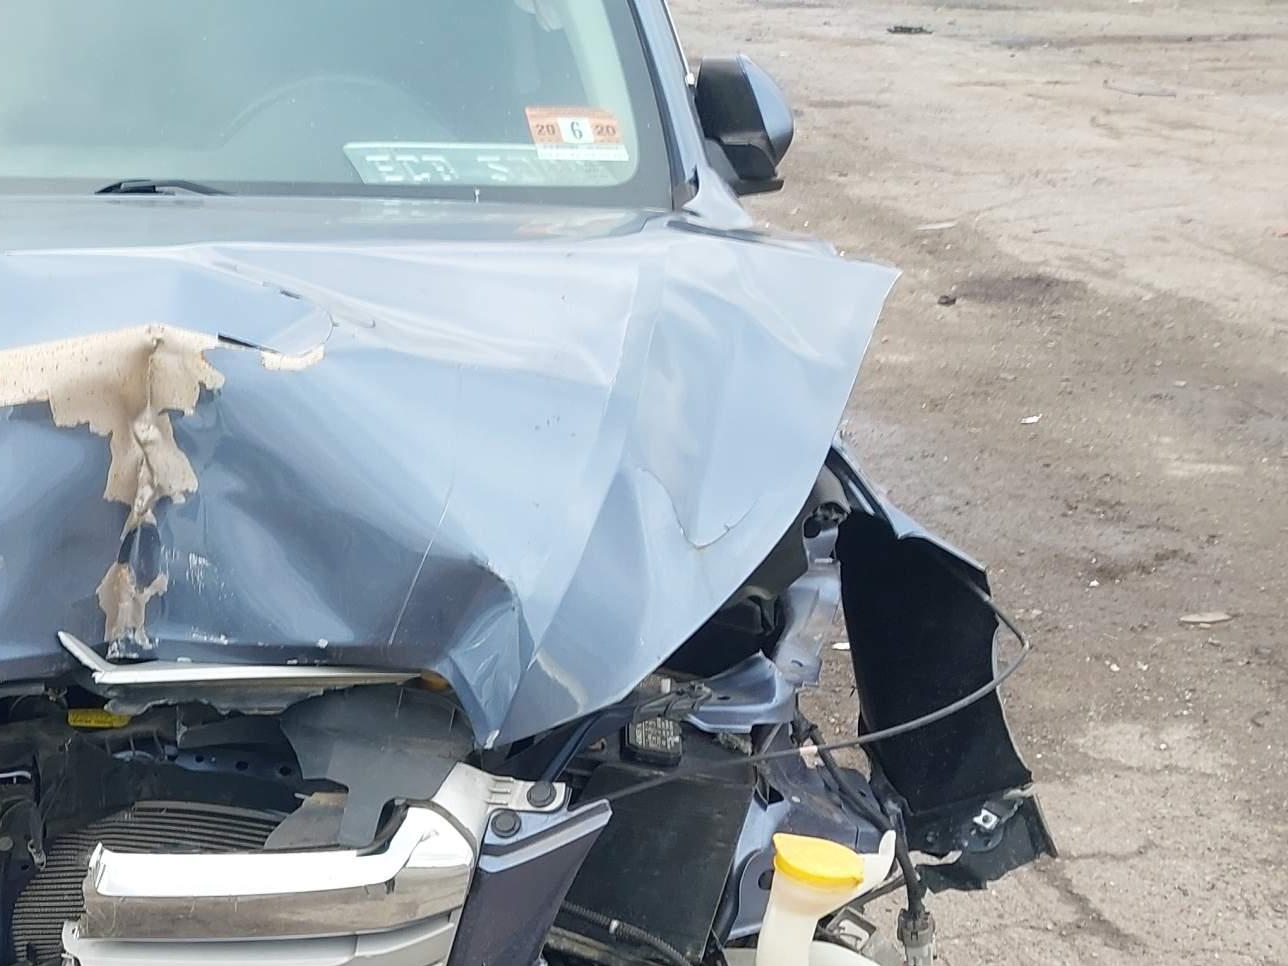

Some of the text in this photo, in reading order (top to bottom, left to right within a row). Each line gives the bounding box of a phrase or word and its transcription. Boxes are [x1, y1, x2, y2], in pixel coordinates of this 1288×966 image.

[535, 120, 617, 140] 20 6 20
